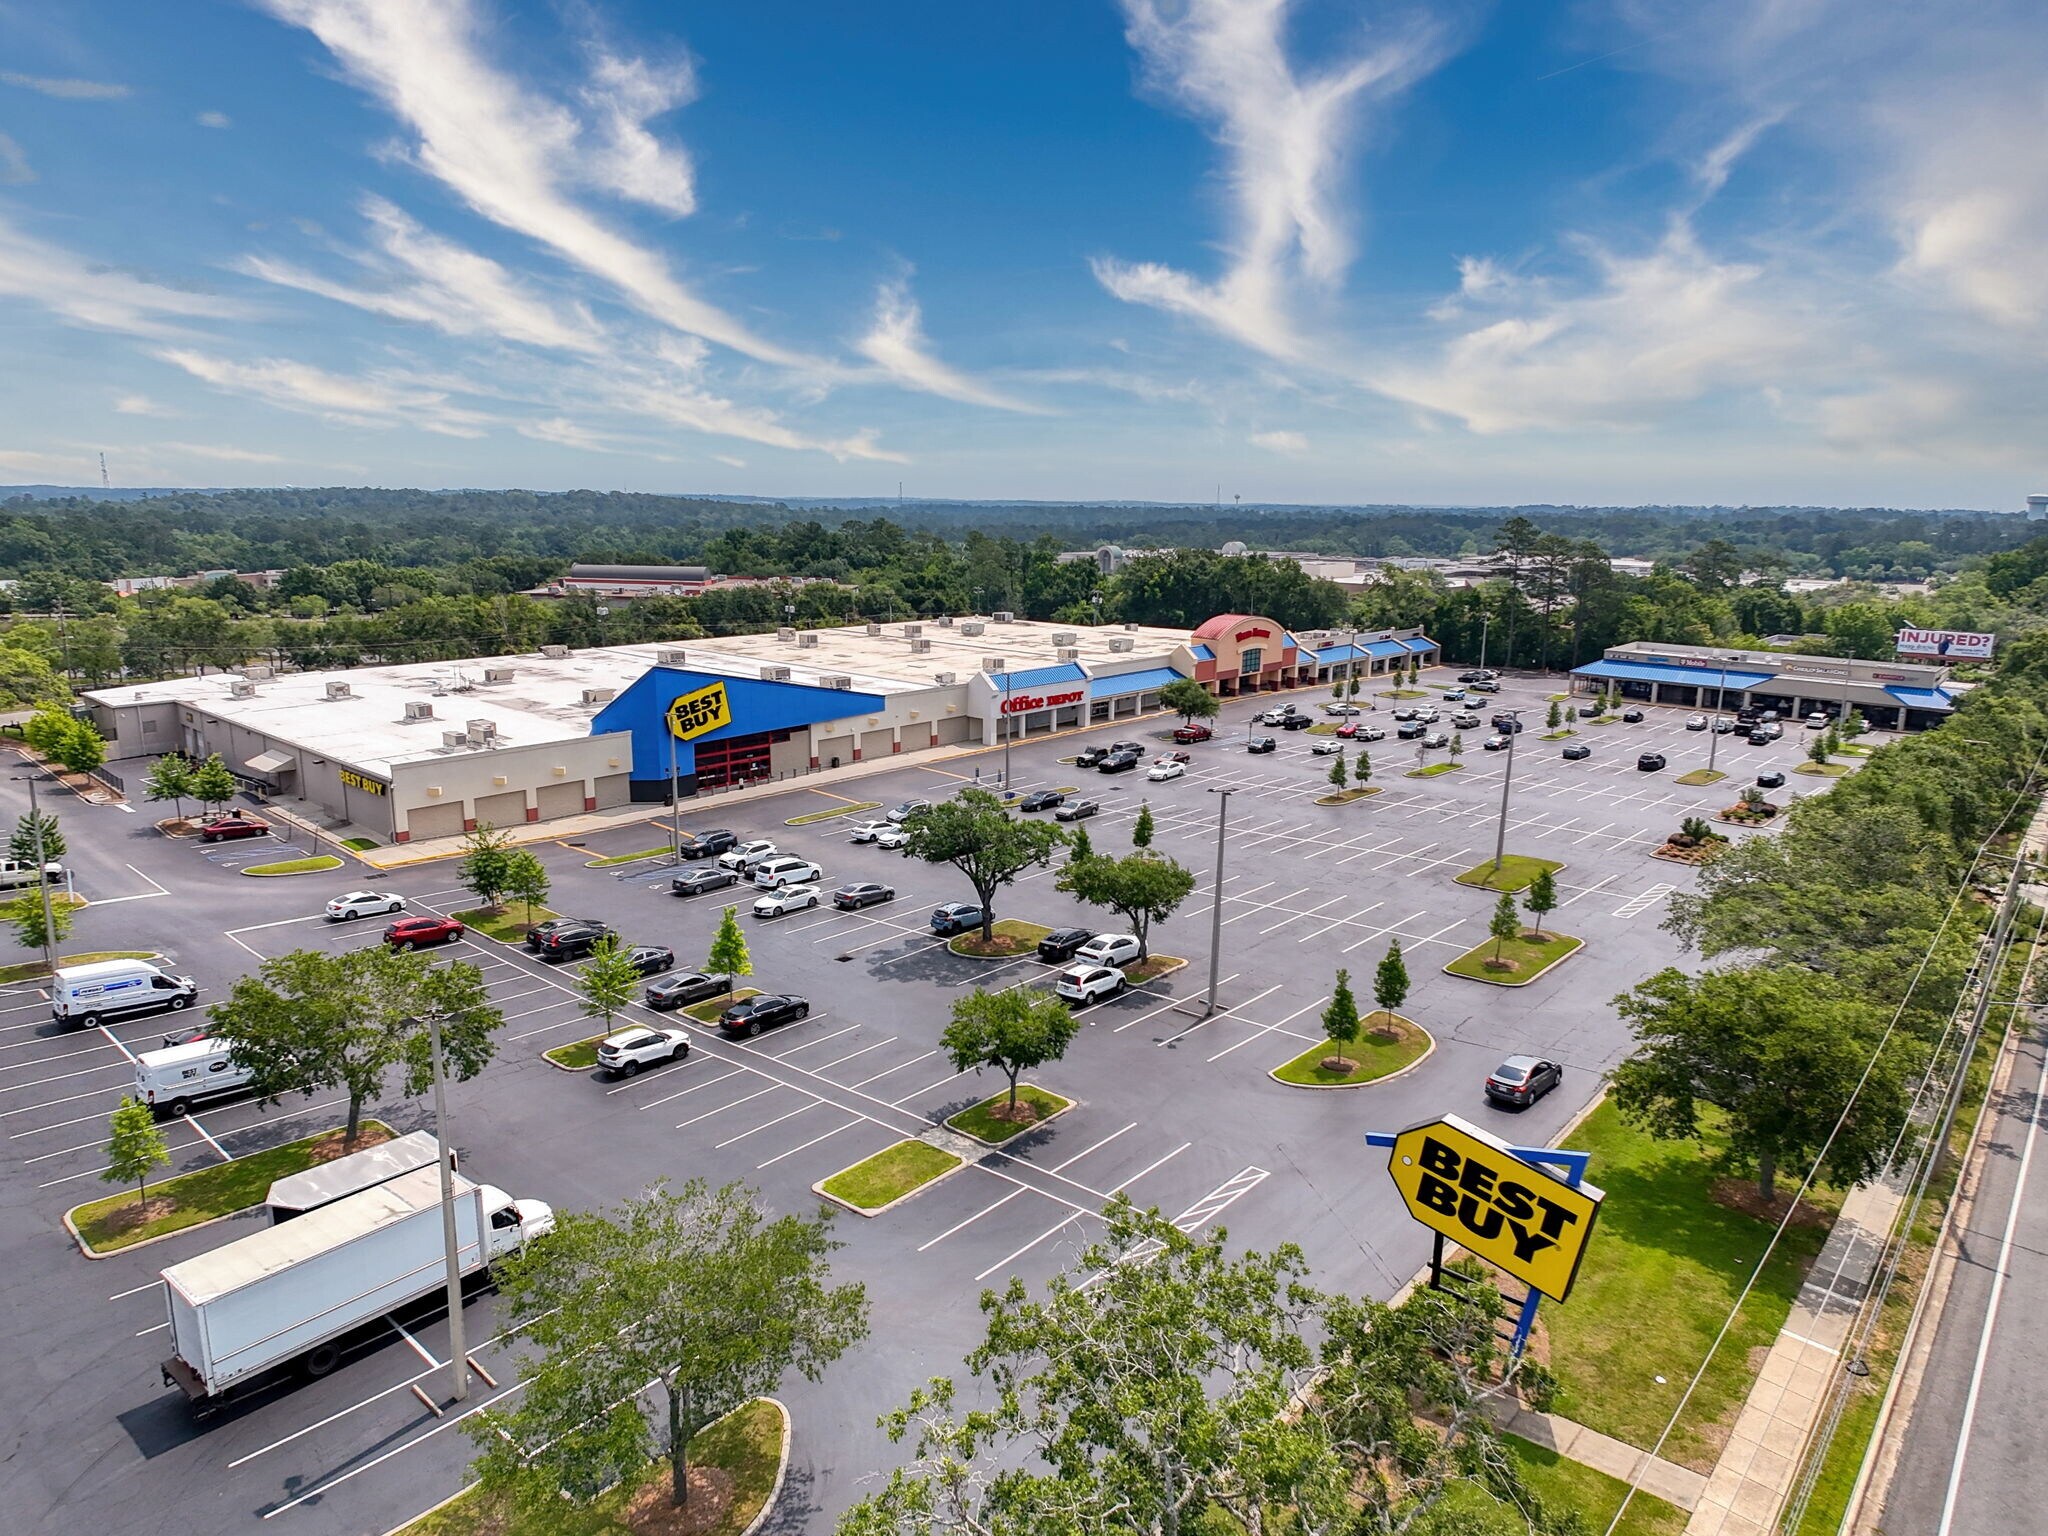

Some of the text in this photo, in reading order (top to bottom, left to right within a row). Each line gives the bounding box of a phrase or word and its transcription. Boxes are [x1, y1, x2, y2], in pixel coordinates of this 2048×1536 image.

[1901, 631, 1991, 647] INJURED?
[675, 690, 722, 720] BEST
[1001, 691, 1084, 714] Office DEPOT
[680, 705, 721, 733] BUY
[339, 769, 382, 796] BEST BUY
[1419, 1136, 1578, 1240] BEST
[1416, 1172, 1557, 1264] BUY
